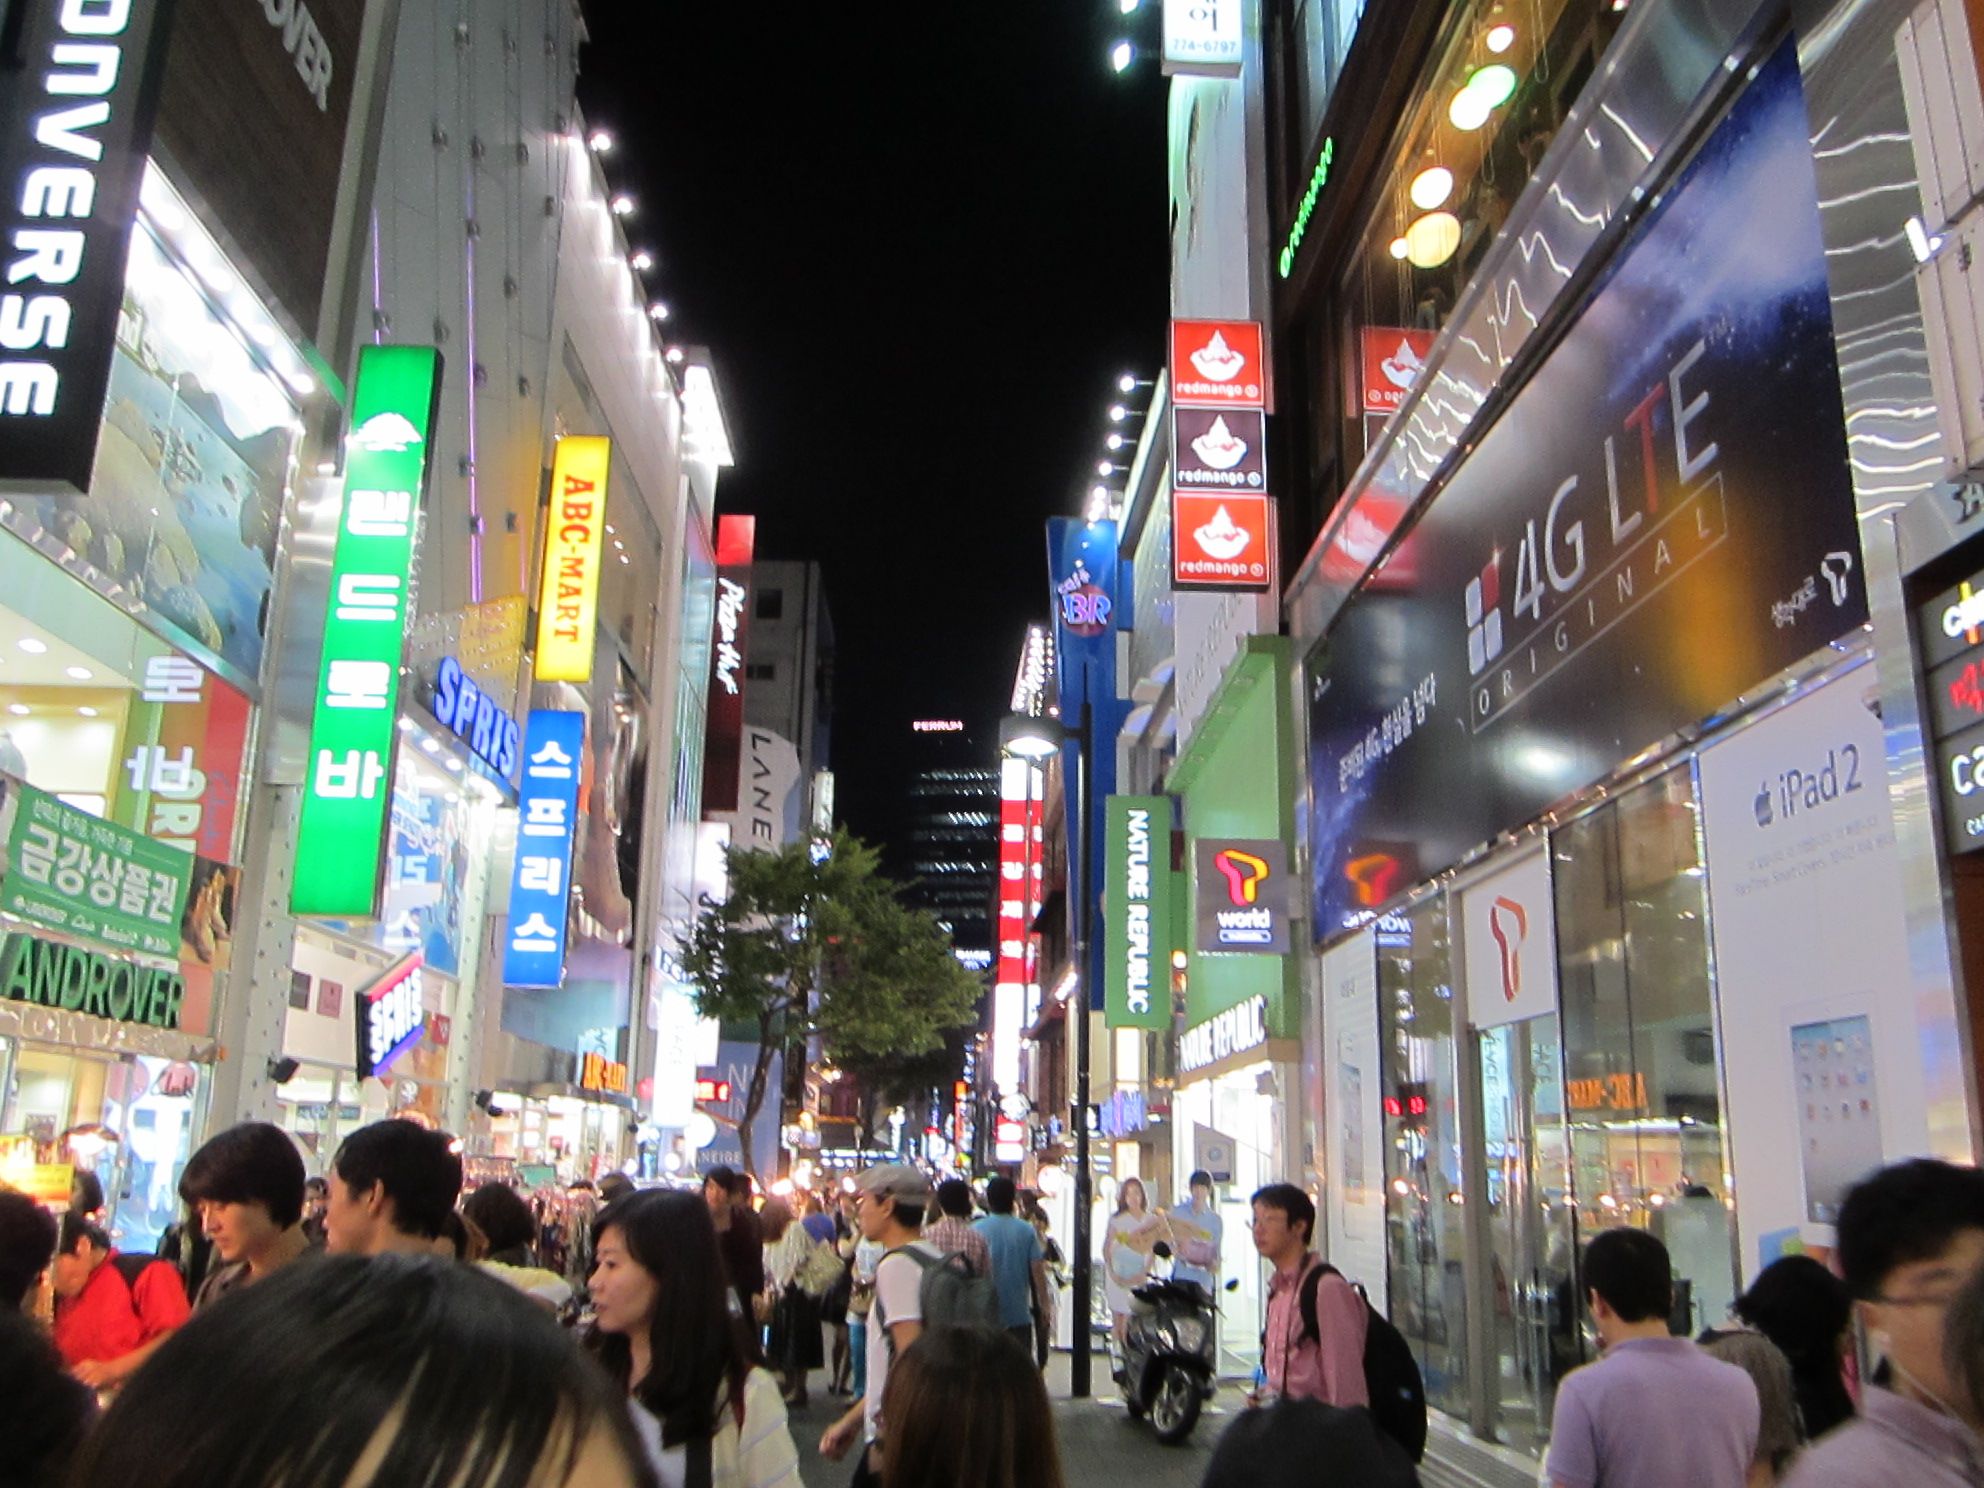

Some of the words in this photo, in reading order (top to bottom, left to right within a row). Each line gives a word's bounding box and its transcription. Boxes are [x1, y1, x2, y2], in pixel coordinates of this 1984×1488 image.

[1176, 382, 1242, 397] redmango
[1178, 470, 1245, 486] redmango
[1512, 474, 1586, 620] 4G
[1604, 338, 1719, 546] LTE
[554, 473, 595, 643] ABC-MART
[1062, 592, 1112, 625] BR
[1180, 560, 1247, 575] redmango
[314, 488, 413, 801] 랜드로바
[1479, 507, 1711, 715] ORIGINAL
[433, 655, 520, 779] SPRIS
[1779, 749, 1839, 818] iPad
[1841, 743, 1863, 793] 2
[20, 821, 179, 924] 금강상품권
[511, 739, 573, 953] 스프리스
[1127, 809, 1150, 900] NATURE
[1127, 904, 1150, 1014] REPUBLIC
[1217, 908, 1271, 929] world
